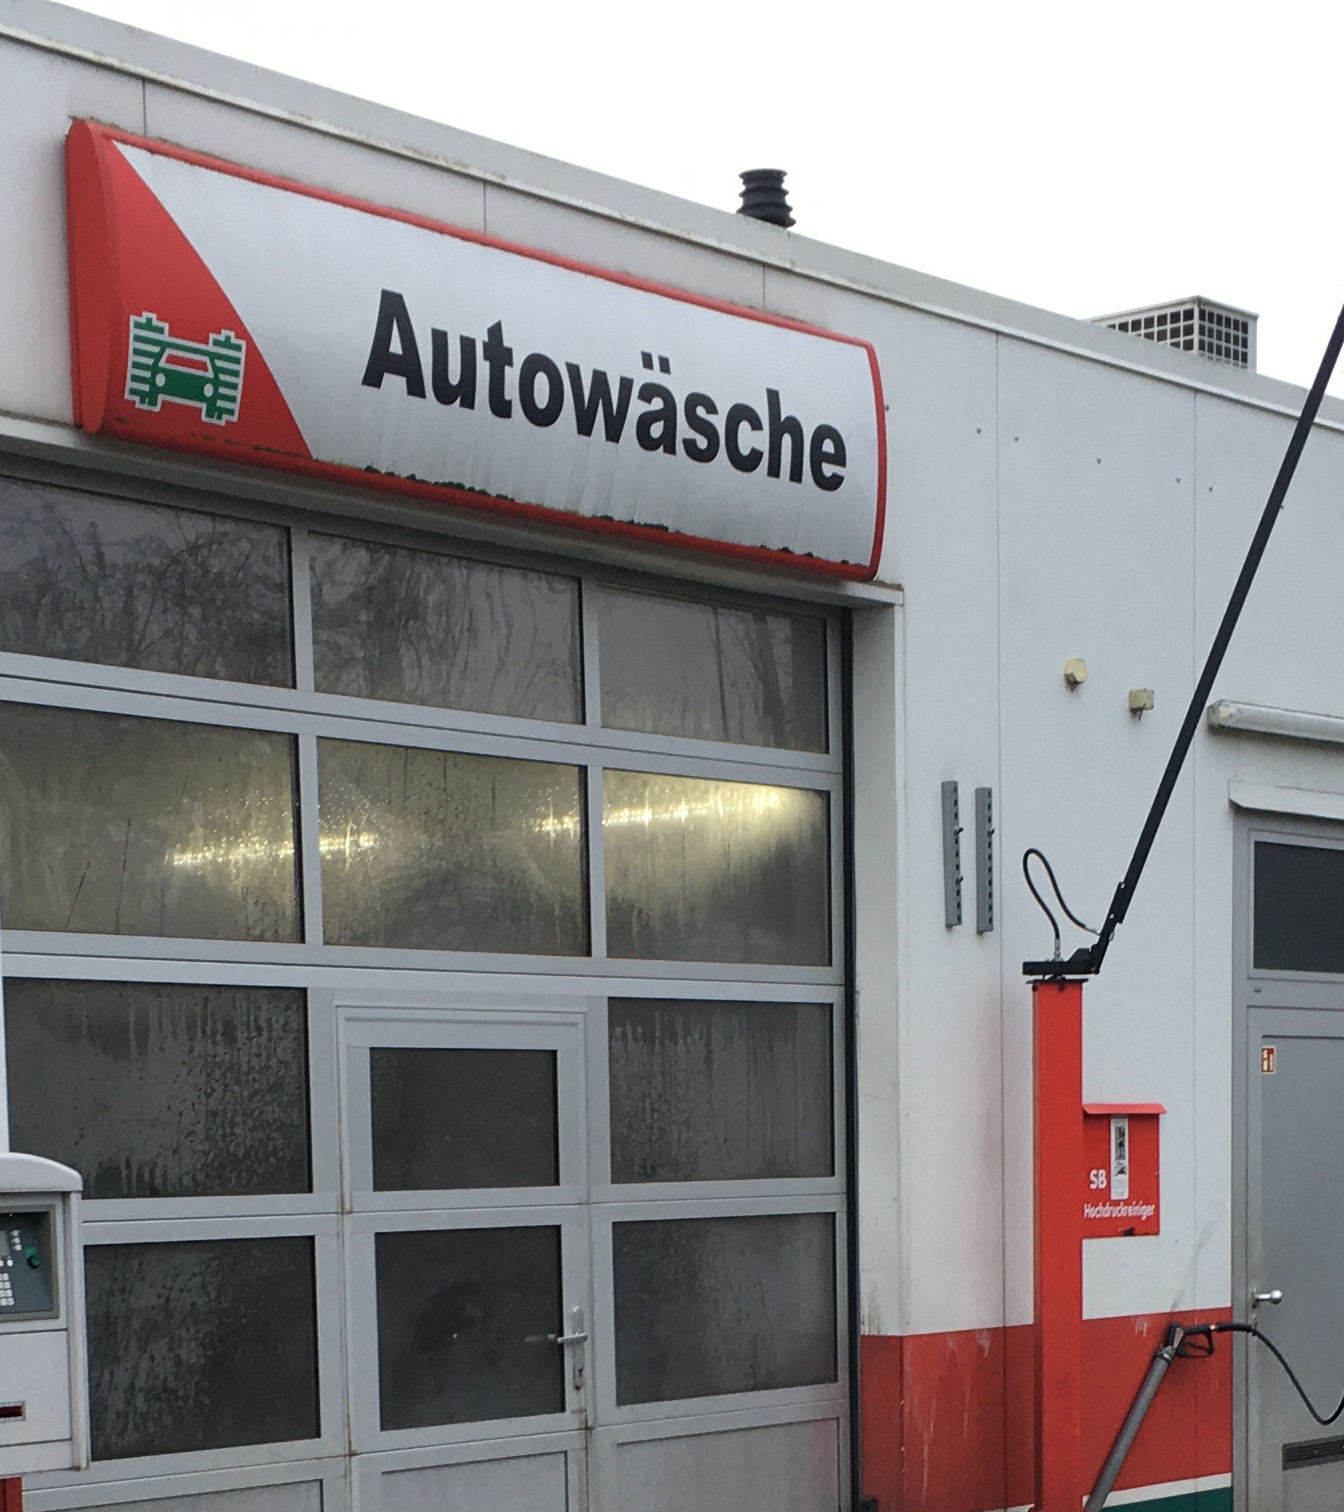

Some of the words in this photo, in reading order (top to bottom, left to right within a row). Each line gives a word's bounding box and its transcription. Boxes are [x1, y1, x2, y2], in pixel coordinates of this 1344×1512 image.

[360, 288, 847, 492] Autowäsche
[1089, 1168, 1107, 1189] SB
[1083, 1200, 1155, 1220] Hochdruckreiniger
